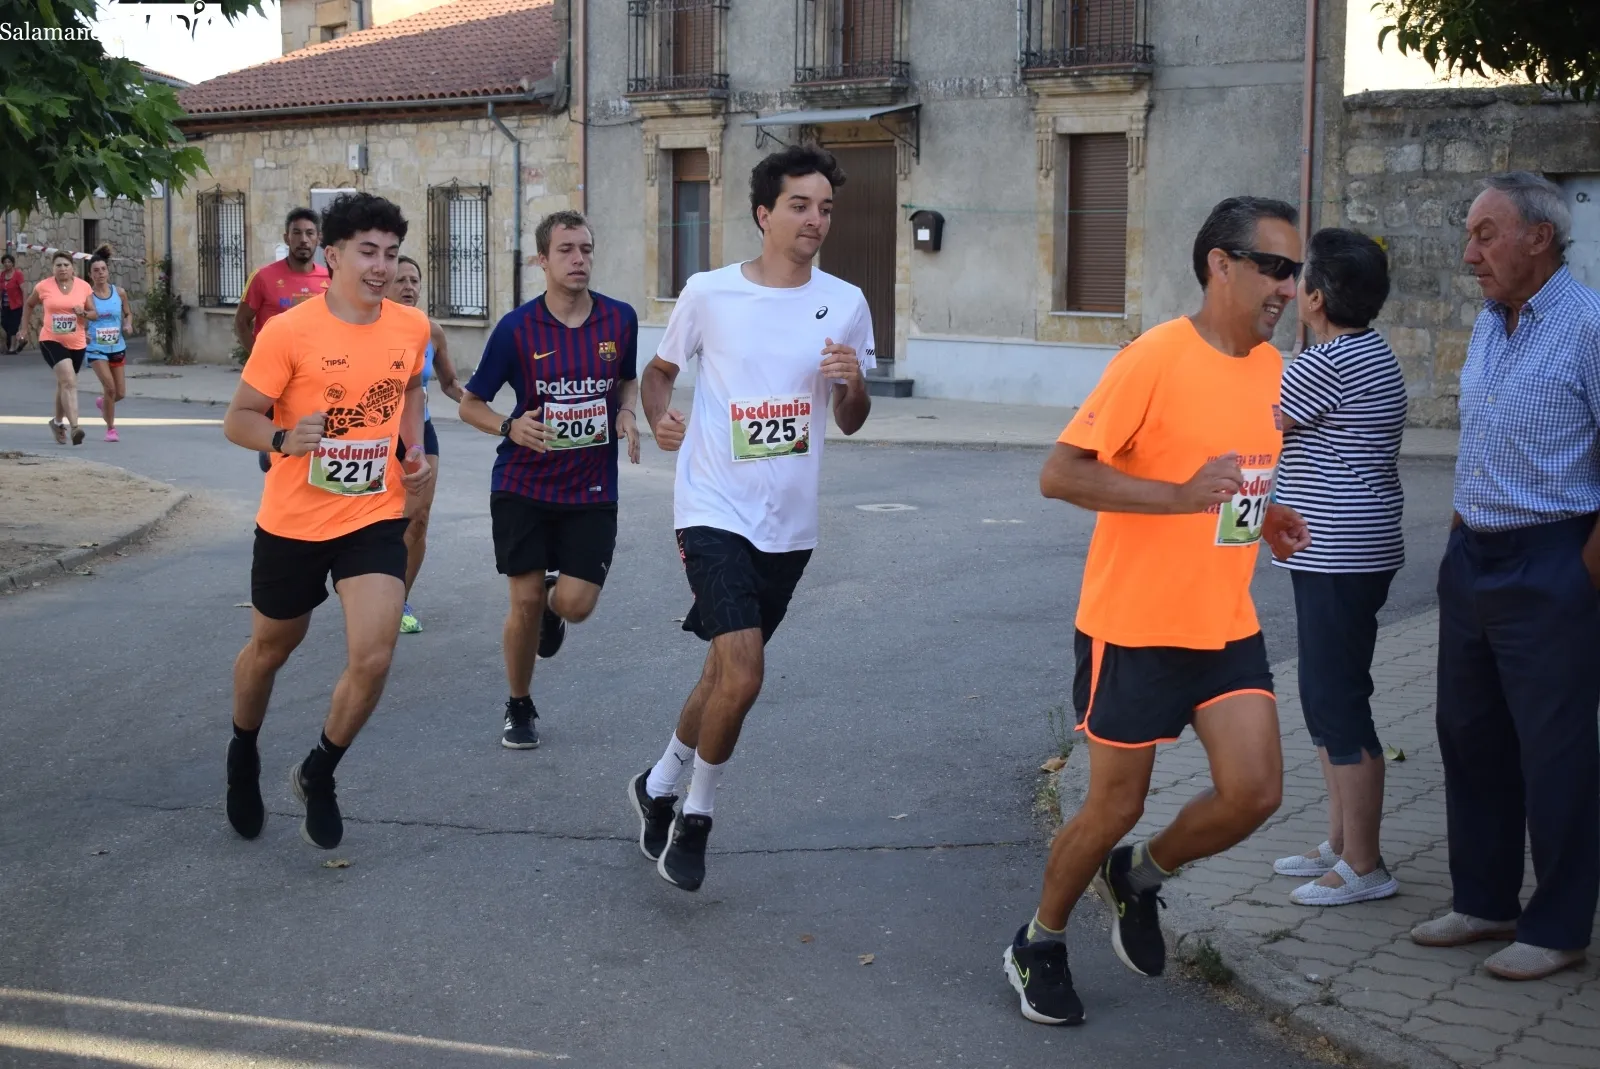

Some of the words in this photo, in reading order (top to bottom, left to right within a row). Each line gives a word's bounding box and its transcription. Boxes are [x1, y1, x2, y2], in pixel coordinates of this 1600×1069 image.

[56, 321, 73, 329] 207
[102, 334, 117, 342] 224
[325, 358, 347, 367] TIPSA
[390, 360, 405, 370] AXA
[365, 391, 395, 408] GASTEIZ
[366, 385, 395, 402] VITORIA
[545, 404, 606, 421] bedunia
[730, 399, 811, 422] bedunia
[557, 419, 596, 439] 206
[748, 418, 797, 445] 225
[326, 461, 373, 483] 221
